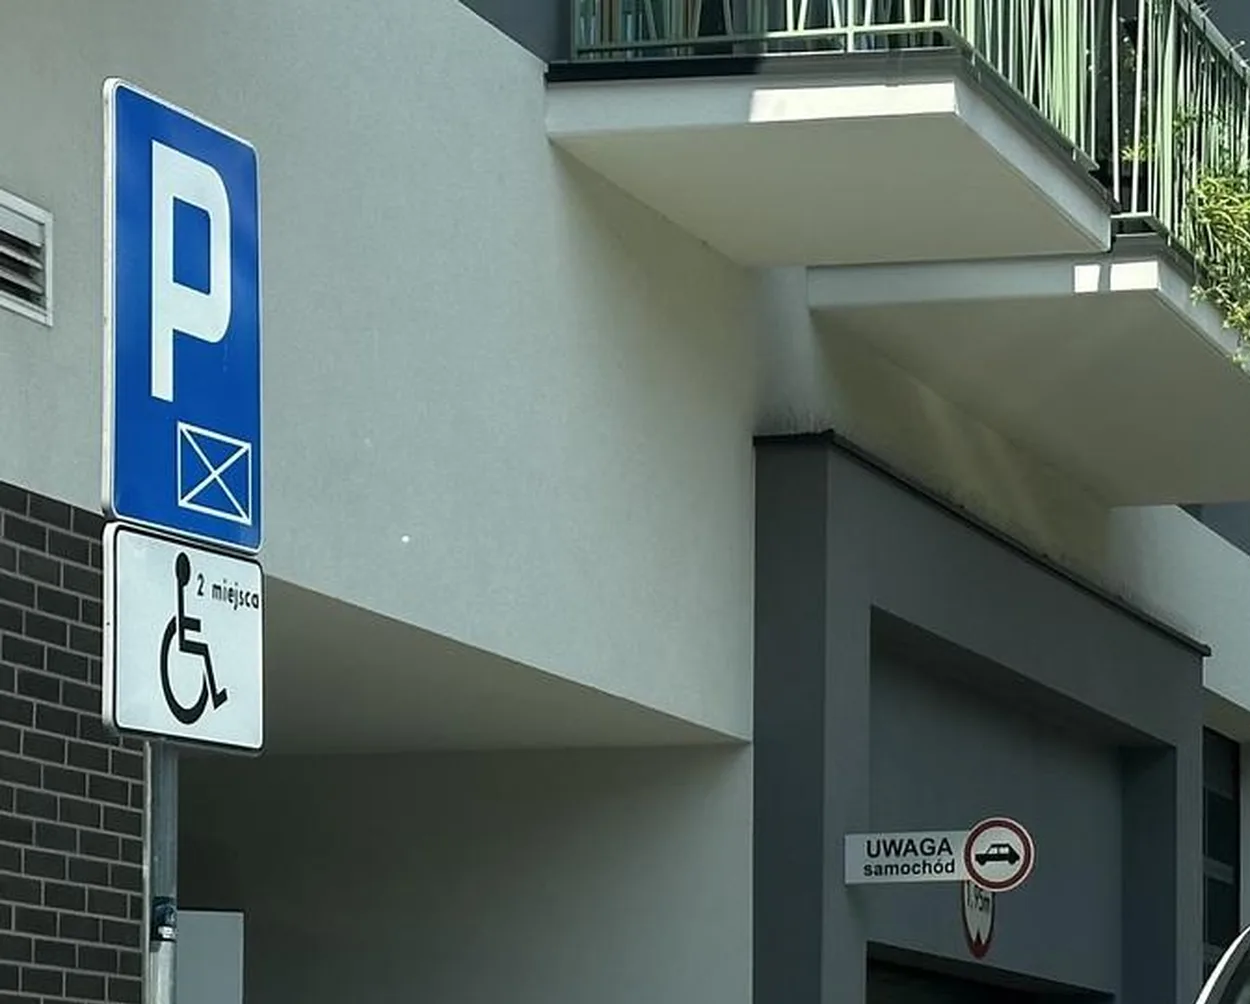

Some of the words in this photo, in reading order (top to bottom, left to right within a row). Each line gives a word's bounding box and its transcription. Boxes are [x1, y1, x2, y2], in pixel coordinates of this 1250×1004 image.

[152, 139, 231, 402] P
[197, 573, 204, 596] 2
[211, 579, 260, 610] miejsca
[866, 838, 953, 858] UWAGA
[863, 859, 955, 876] samochód
